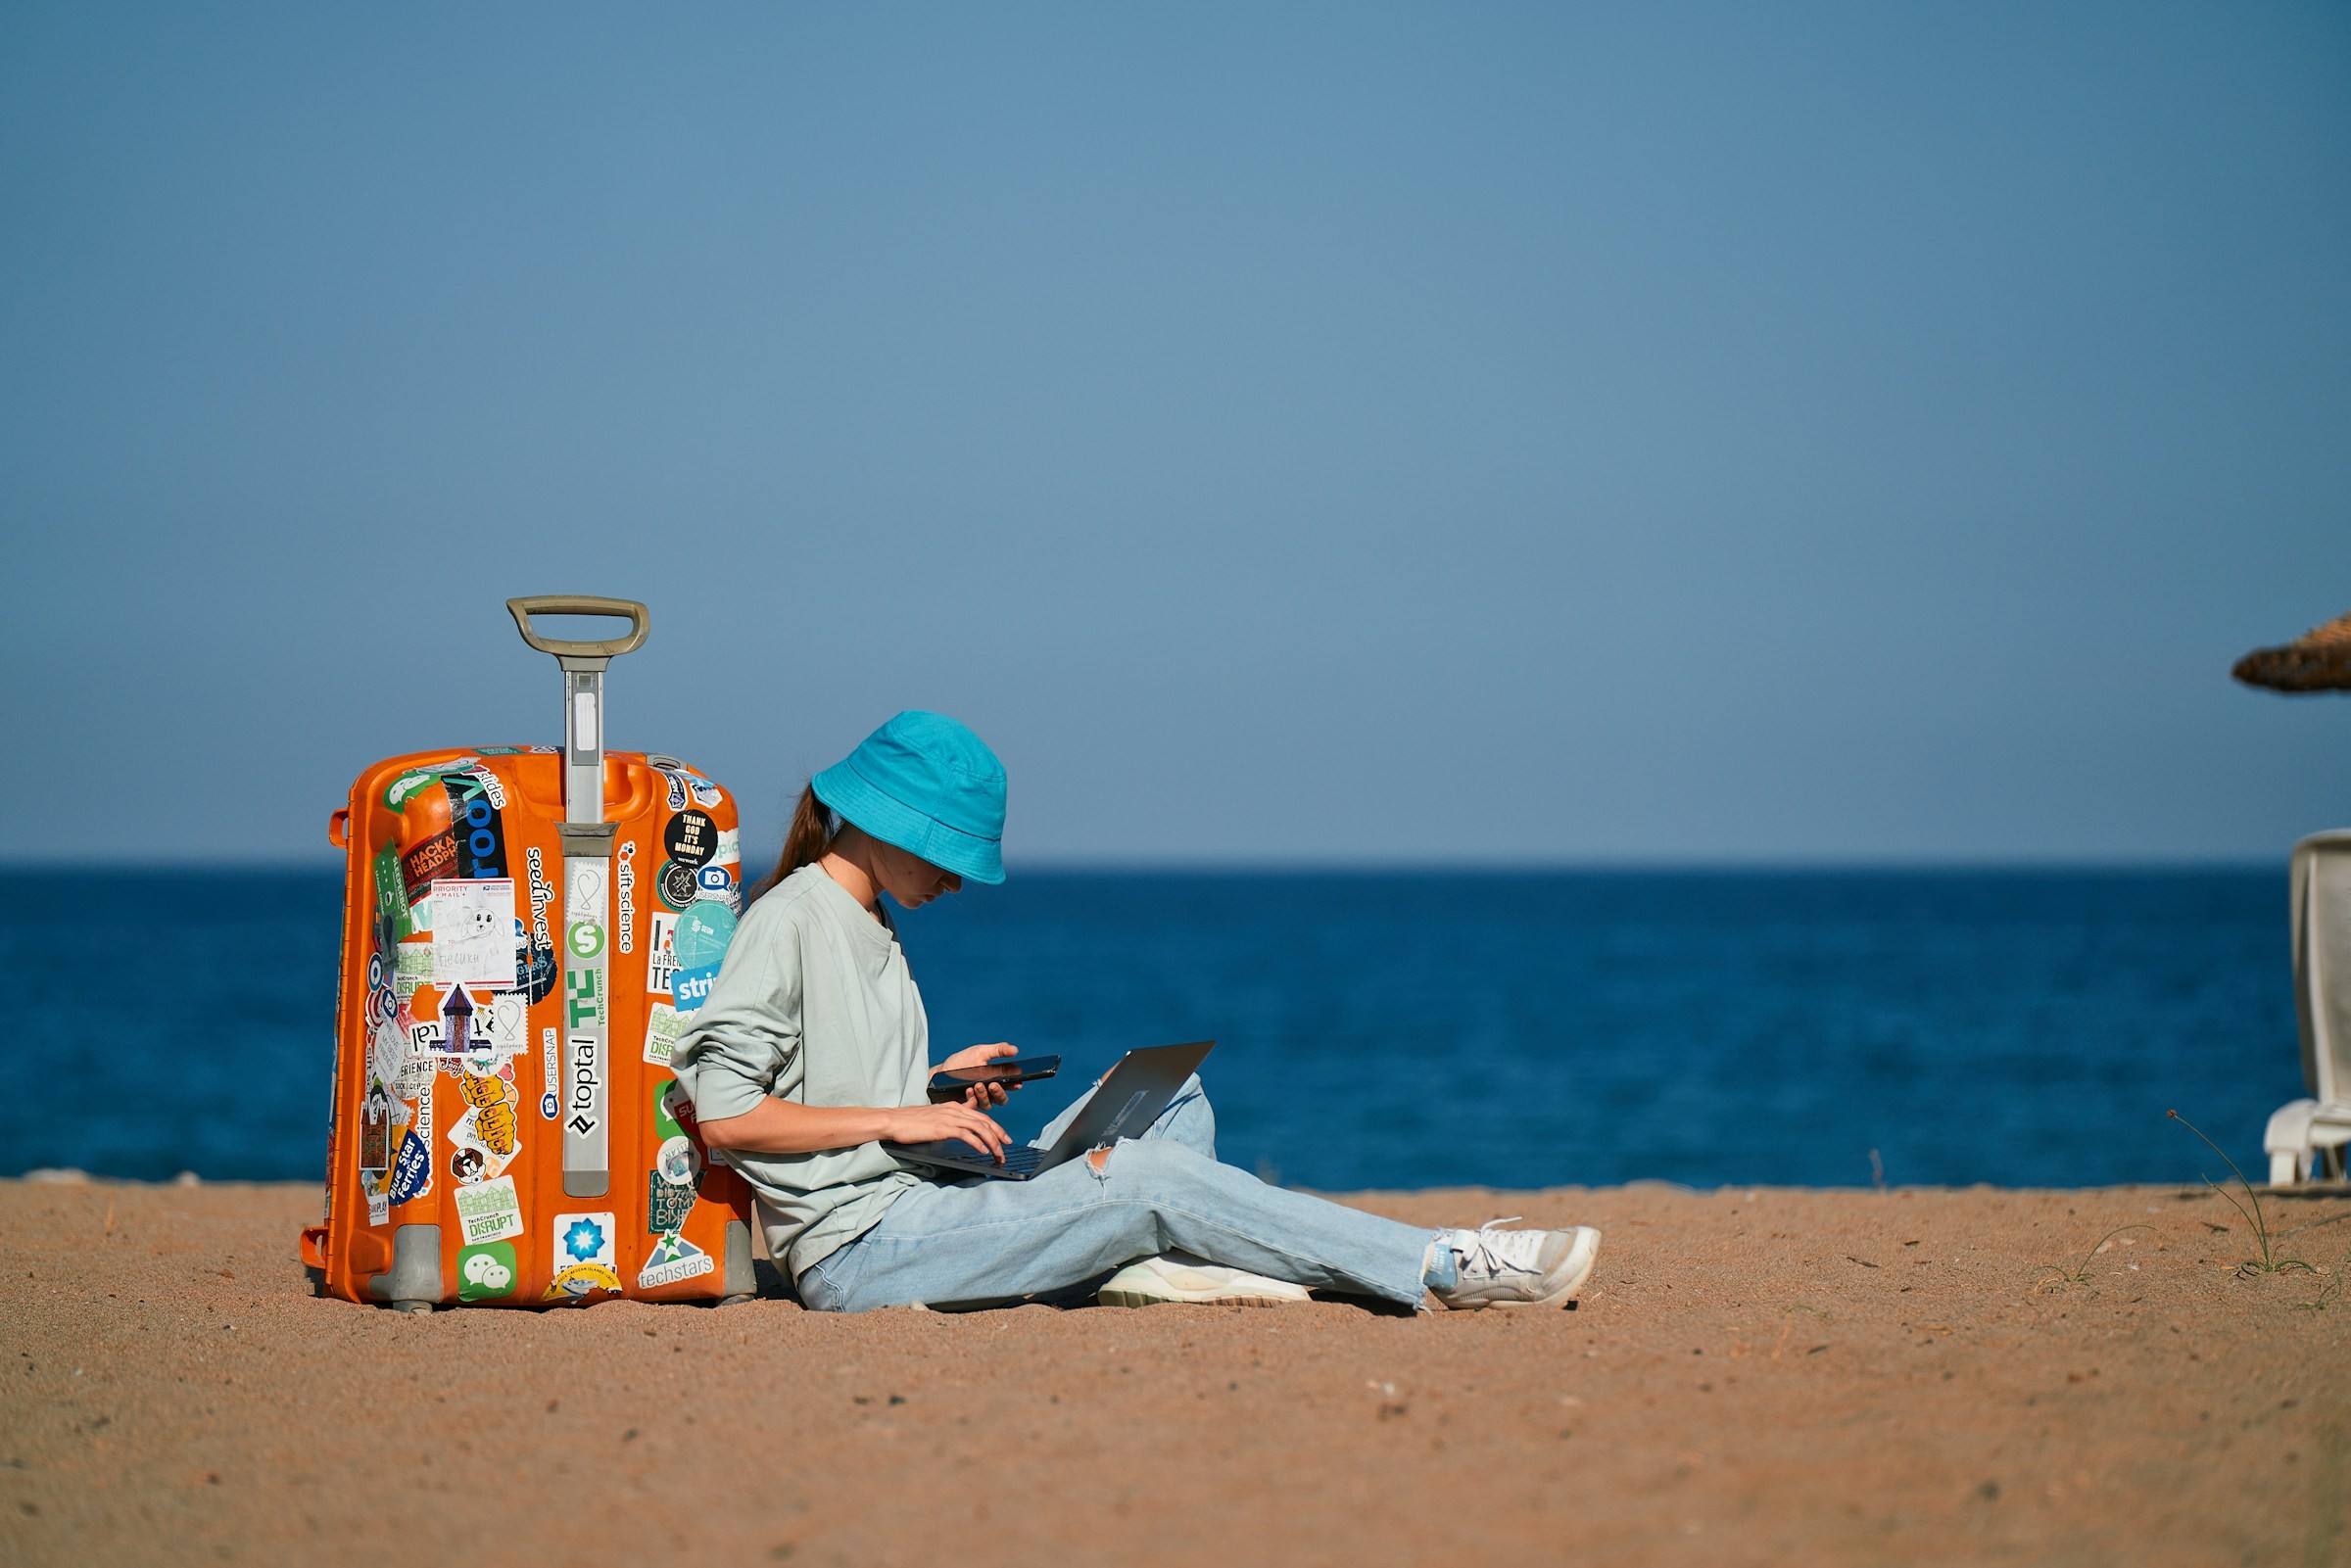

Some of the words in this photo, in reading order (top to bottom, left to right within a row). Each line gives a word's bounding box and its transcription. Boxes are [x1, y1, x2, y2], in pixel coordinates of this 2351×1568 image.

[478, 773, 504, 808] slides
[683, 814, 705, 827] THANK
[685, 825, 700, 835] GOD
[674, 842, 704, 856] MONDAY
[684, 834, 698, 844] IT'S
[393, 855, 408, 918] SLEEPERBOT
[620, 864, 633, 888] sift
[528, 848, 553, 950] seedinvest
[621, 891, 635, 952] science
[653, 920, 661, 952] I
[652, 953, 661, 966] La
[594, 968, 606, 1026] TechCrunch
[678, 972, 720, 1001] stri
[545, 1029, 558, 1093] USERSNAP
[572, 1038, 599, 1111] toptal
[417, 1085, 431, 1149] science
[388, 1168, 403, 1200] Blue
[398, 1138, 416, 1166] Star
[397, 1153, 424, 1200] Ferries
[467, 1212, 500, 1224] TechCrunch
[469, 1213, 513, 1237] DISRUPT
[639, 1259, 713, 1288] techstars
